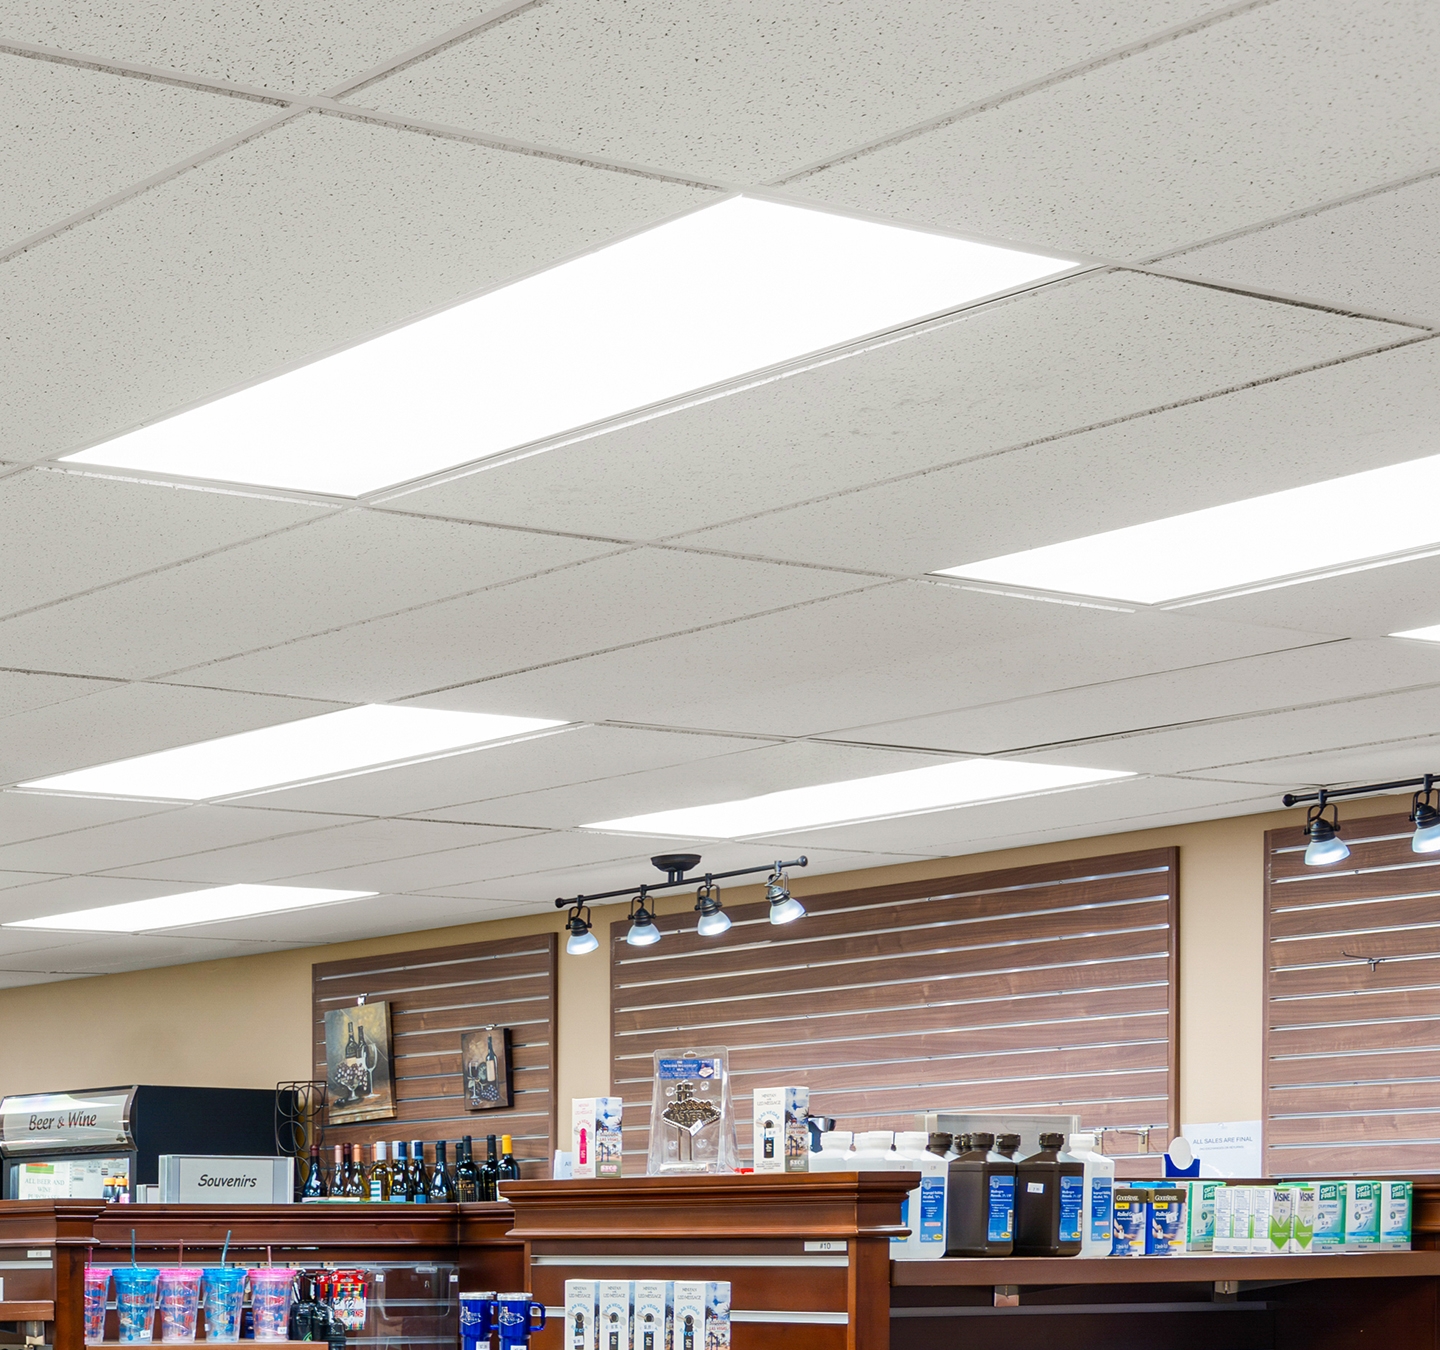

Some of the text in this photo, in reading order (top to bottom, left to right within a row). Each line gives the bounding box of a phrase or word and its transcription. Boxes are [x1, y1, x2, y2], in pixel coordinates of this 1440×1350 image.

[29, 1111, 97, 1131] Beer & Wine
[1193, 1135, 1253, 1145] ALL SALES ARE FINAL
[198, 1172, 256, 1188] Souvenirs
[1273, 1192, 1290, 1201] VISINE
[1300, 1192, 1314, 1201] VISINE
[1321, 1191, 1336, 1199] FREE
[819, 1242, 831, 1250] #10
